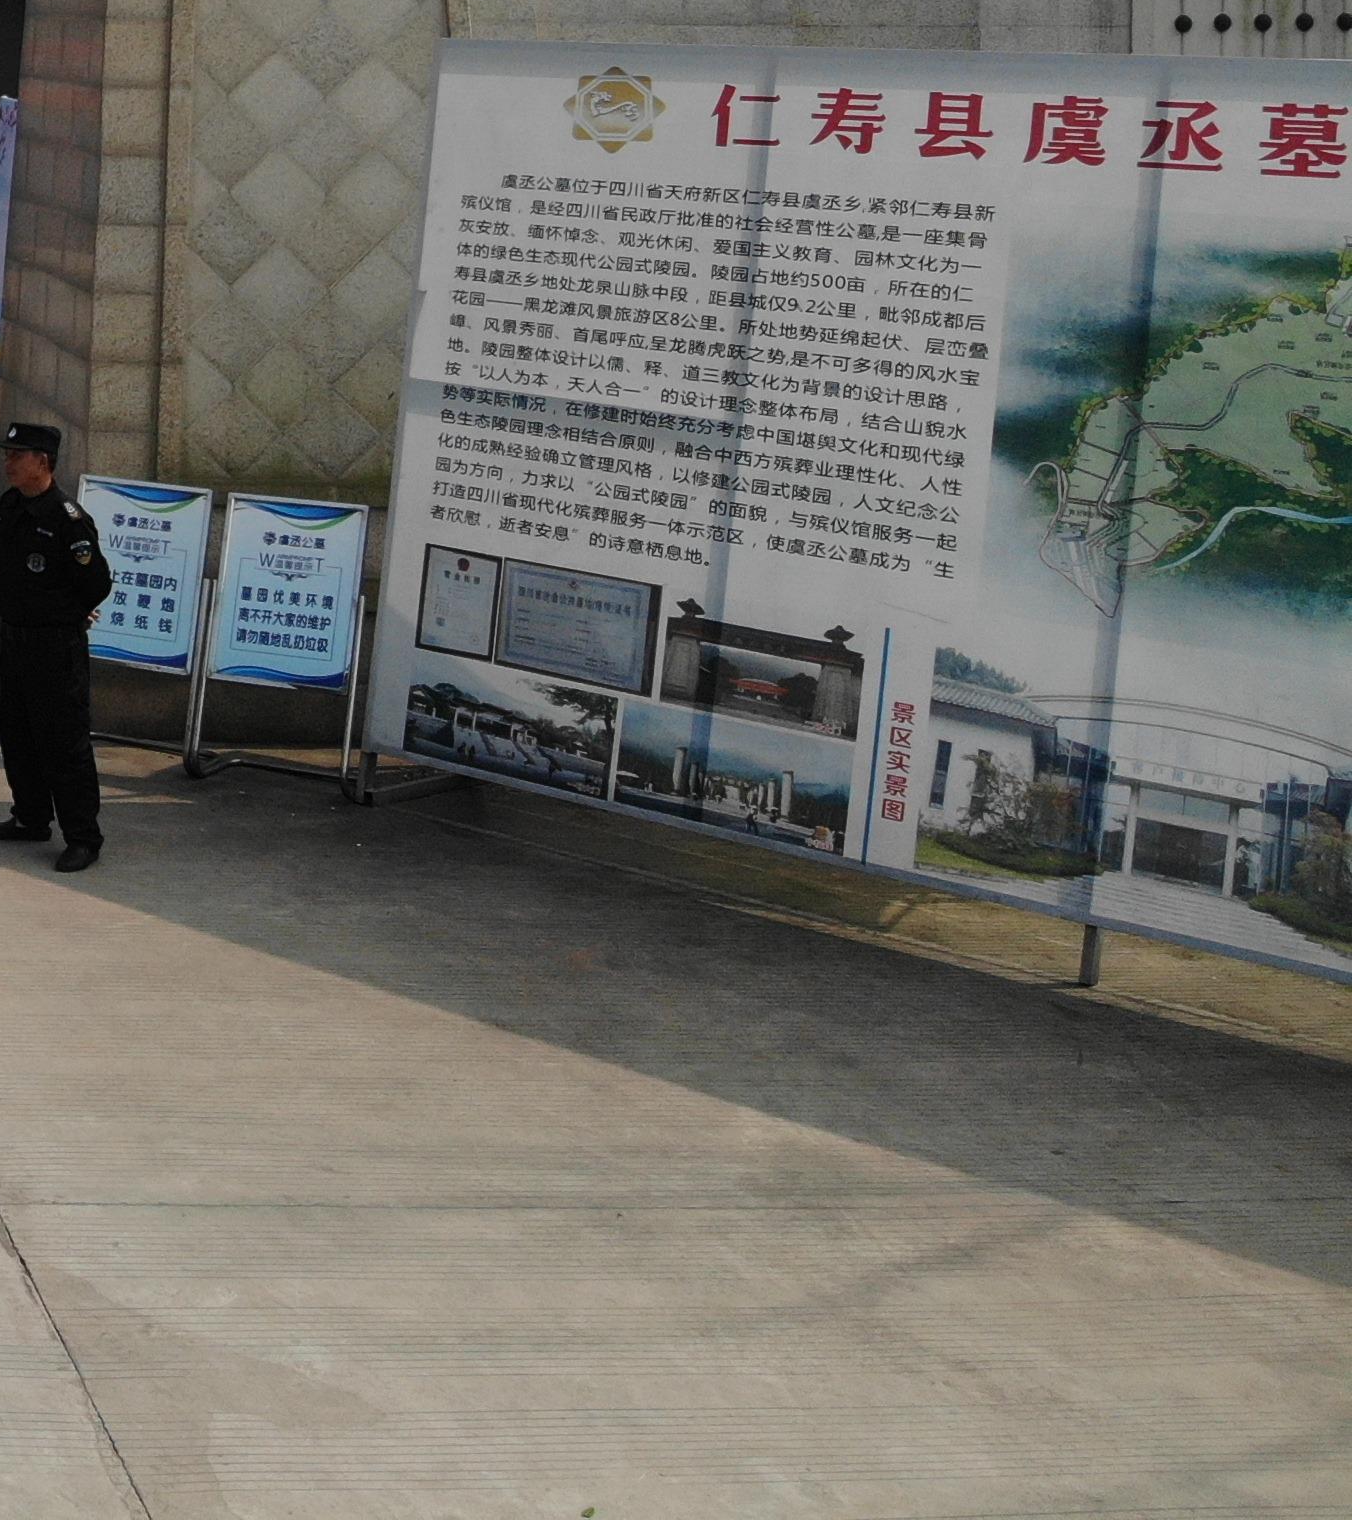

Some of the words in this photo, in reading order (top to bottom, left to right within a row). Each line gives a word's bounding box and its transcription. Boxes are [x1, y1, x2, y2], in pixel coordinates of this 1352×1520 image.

[710, 83, 1349, 180] 仁寿县虞丞墓
